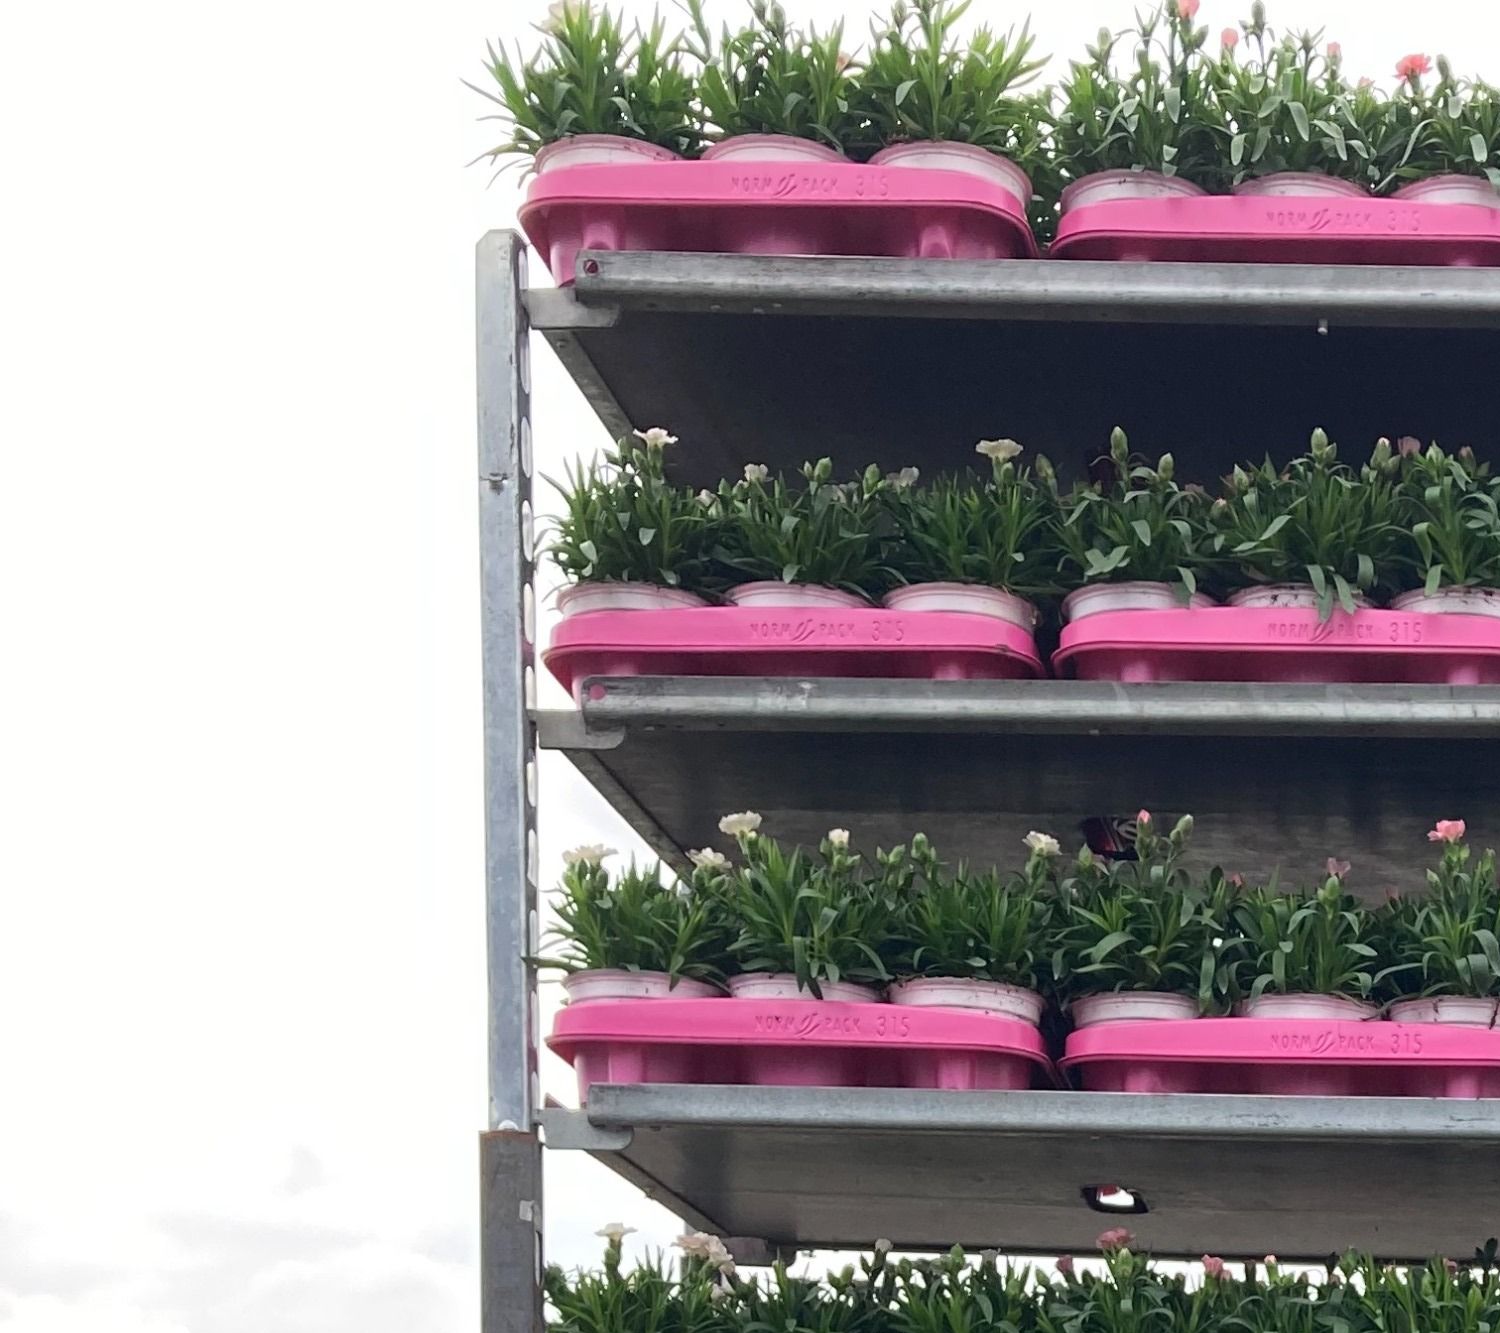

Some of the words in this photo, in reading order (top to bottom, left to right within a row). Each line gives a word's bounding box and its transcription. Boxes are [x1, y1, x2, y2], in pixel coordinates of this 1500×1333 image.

[750, 622, 791, 639] NORM
[819, 622, 855, 639] PACK
[871, 620, 904, 641] 315
[755, 1015, 795, 1033] NORM
[825, 1015, 862, 1033] PACK
[875, 1014, 909, 1037] 315
[1271, 1034, 1312, 1050] NORM
[1339, 1034, 1375, 1050] PACK
[1390, 1033, 1423, 1054] 315
